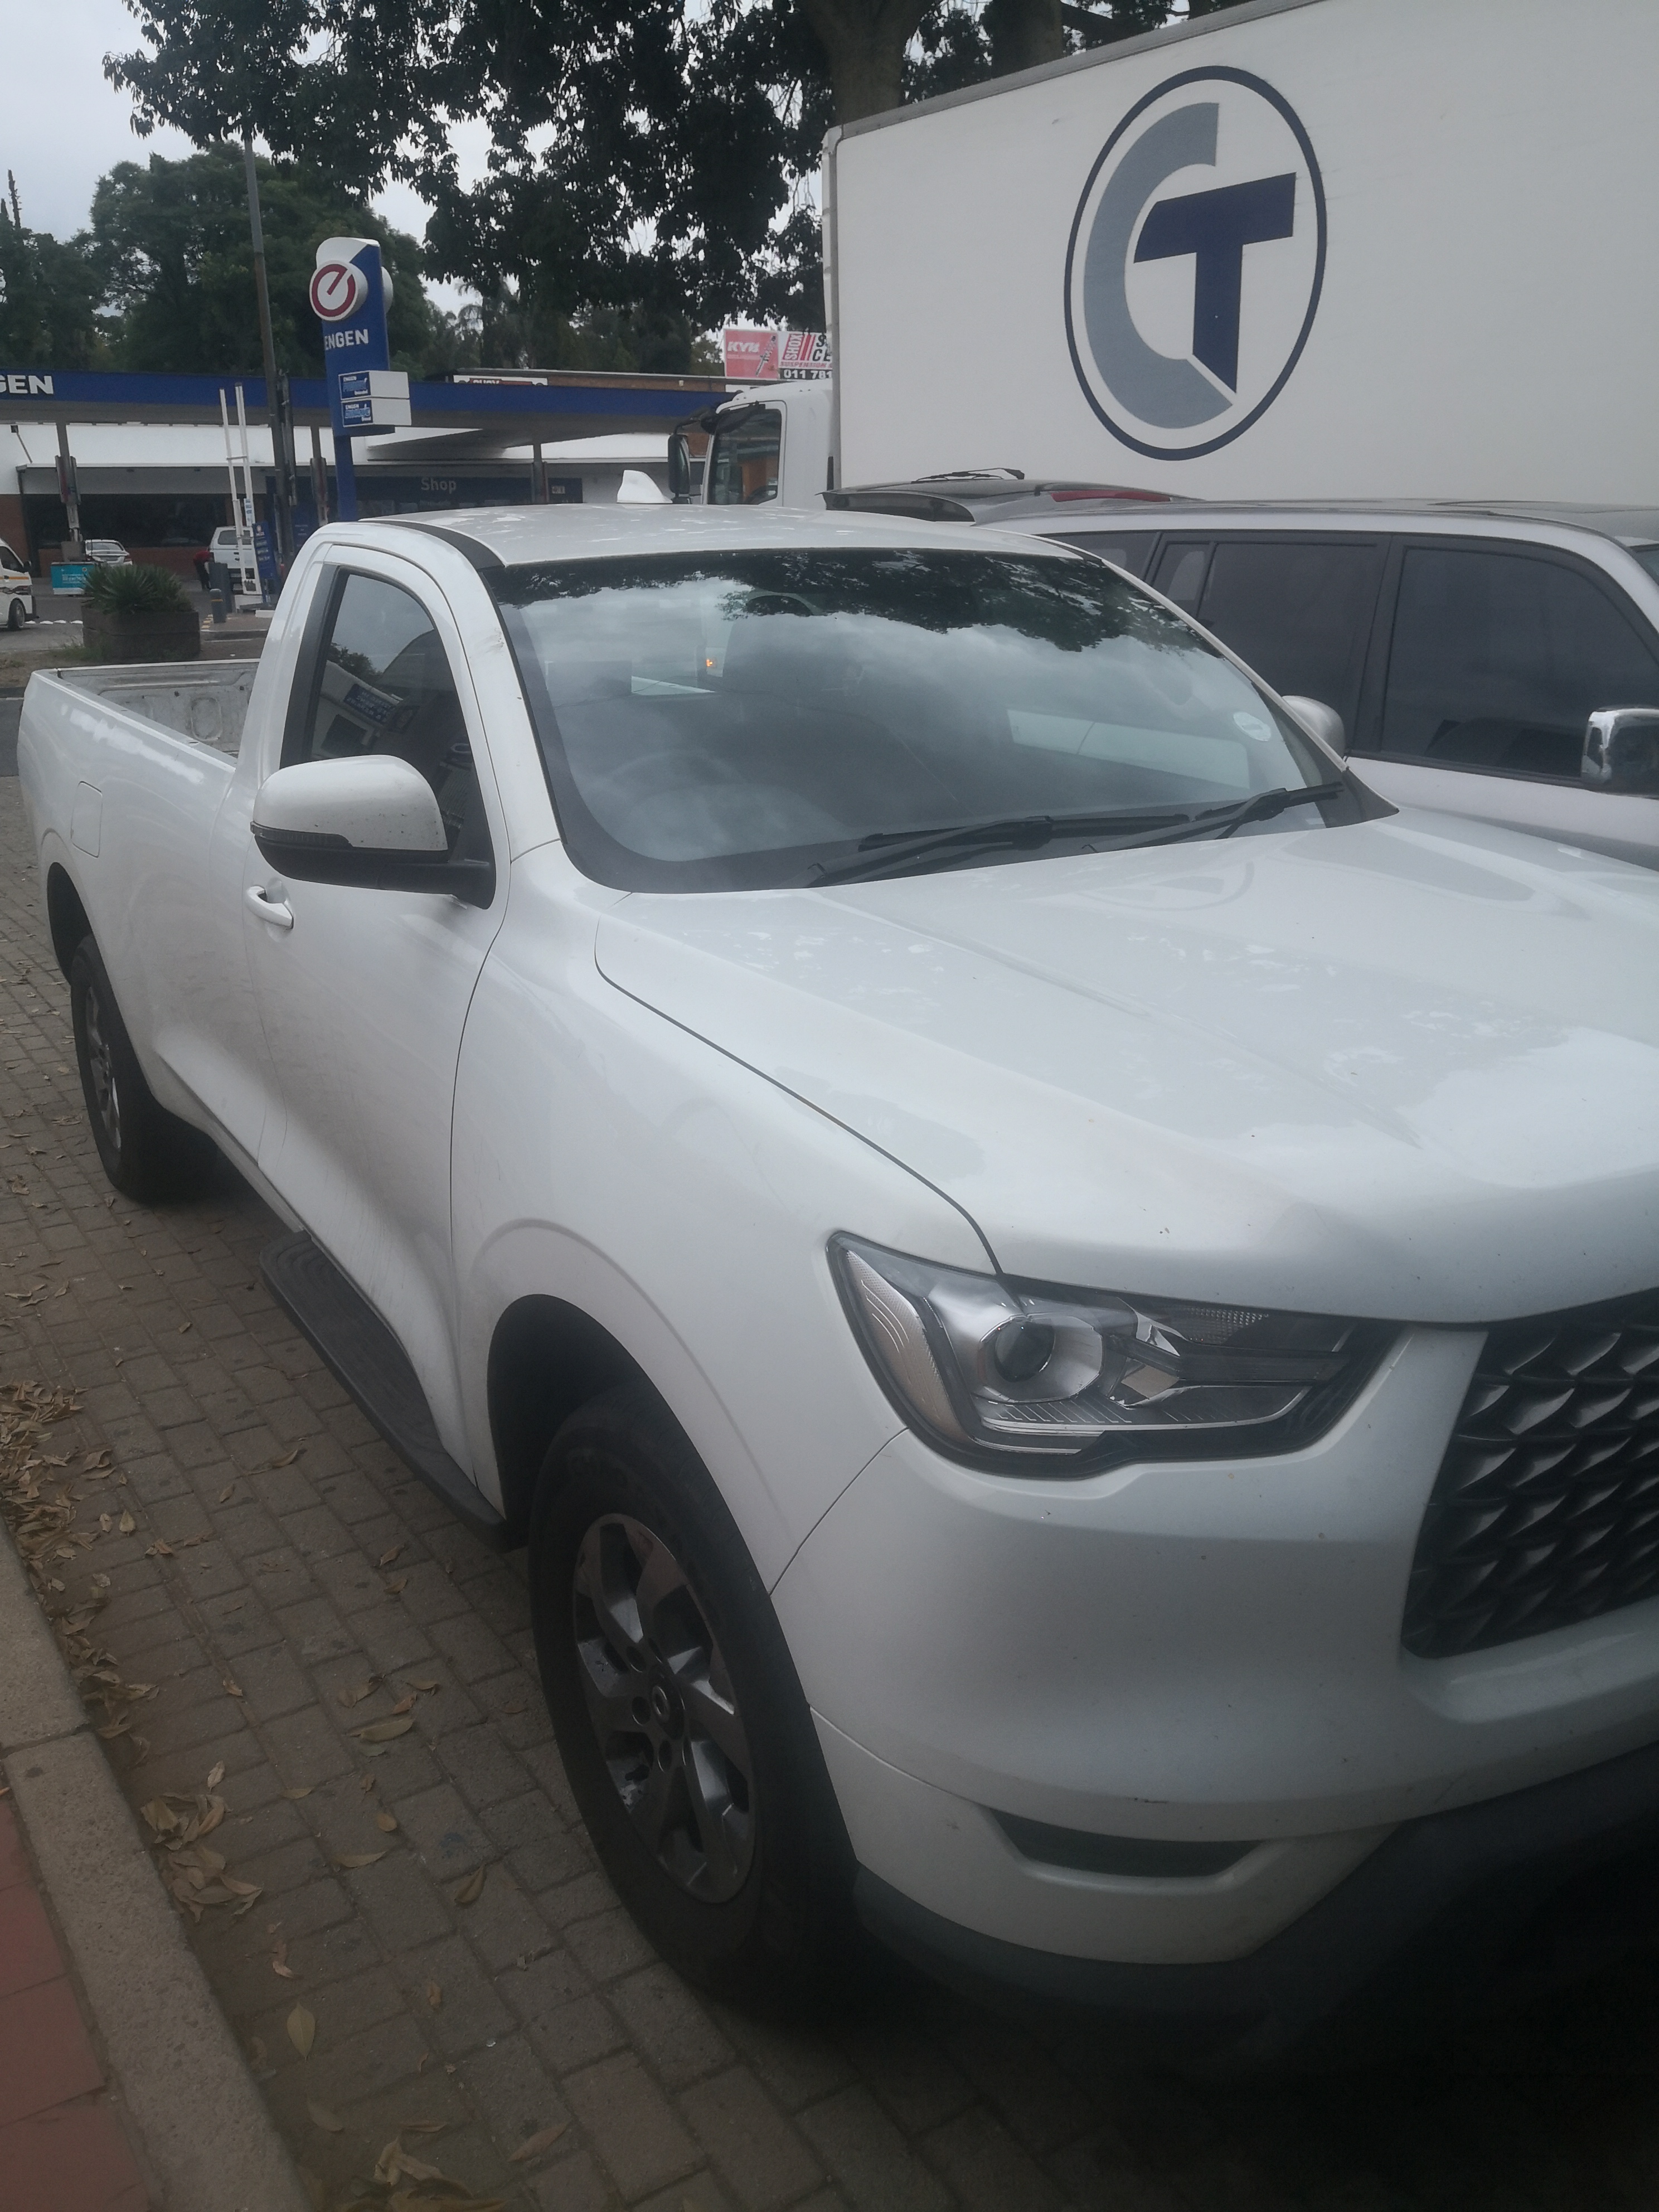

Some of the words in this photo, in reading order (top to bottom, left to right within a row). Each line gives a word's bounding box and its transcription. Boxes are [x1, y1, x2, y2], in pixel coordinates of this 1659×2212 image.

[324, 328, 369, 351] ENGEN
[783, 369, 806, 379] 011
[421, 477, 457, 494] Shop
